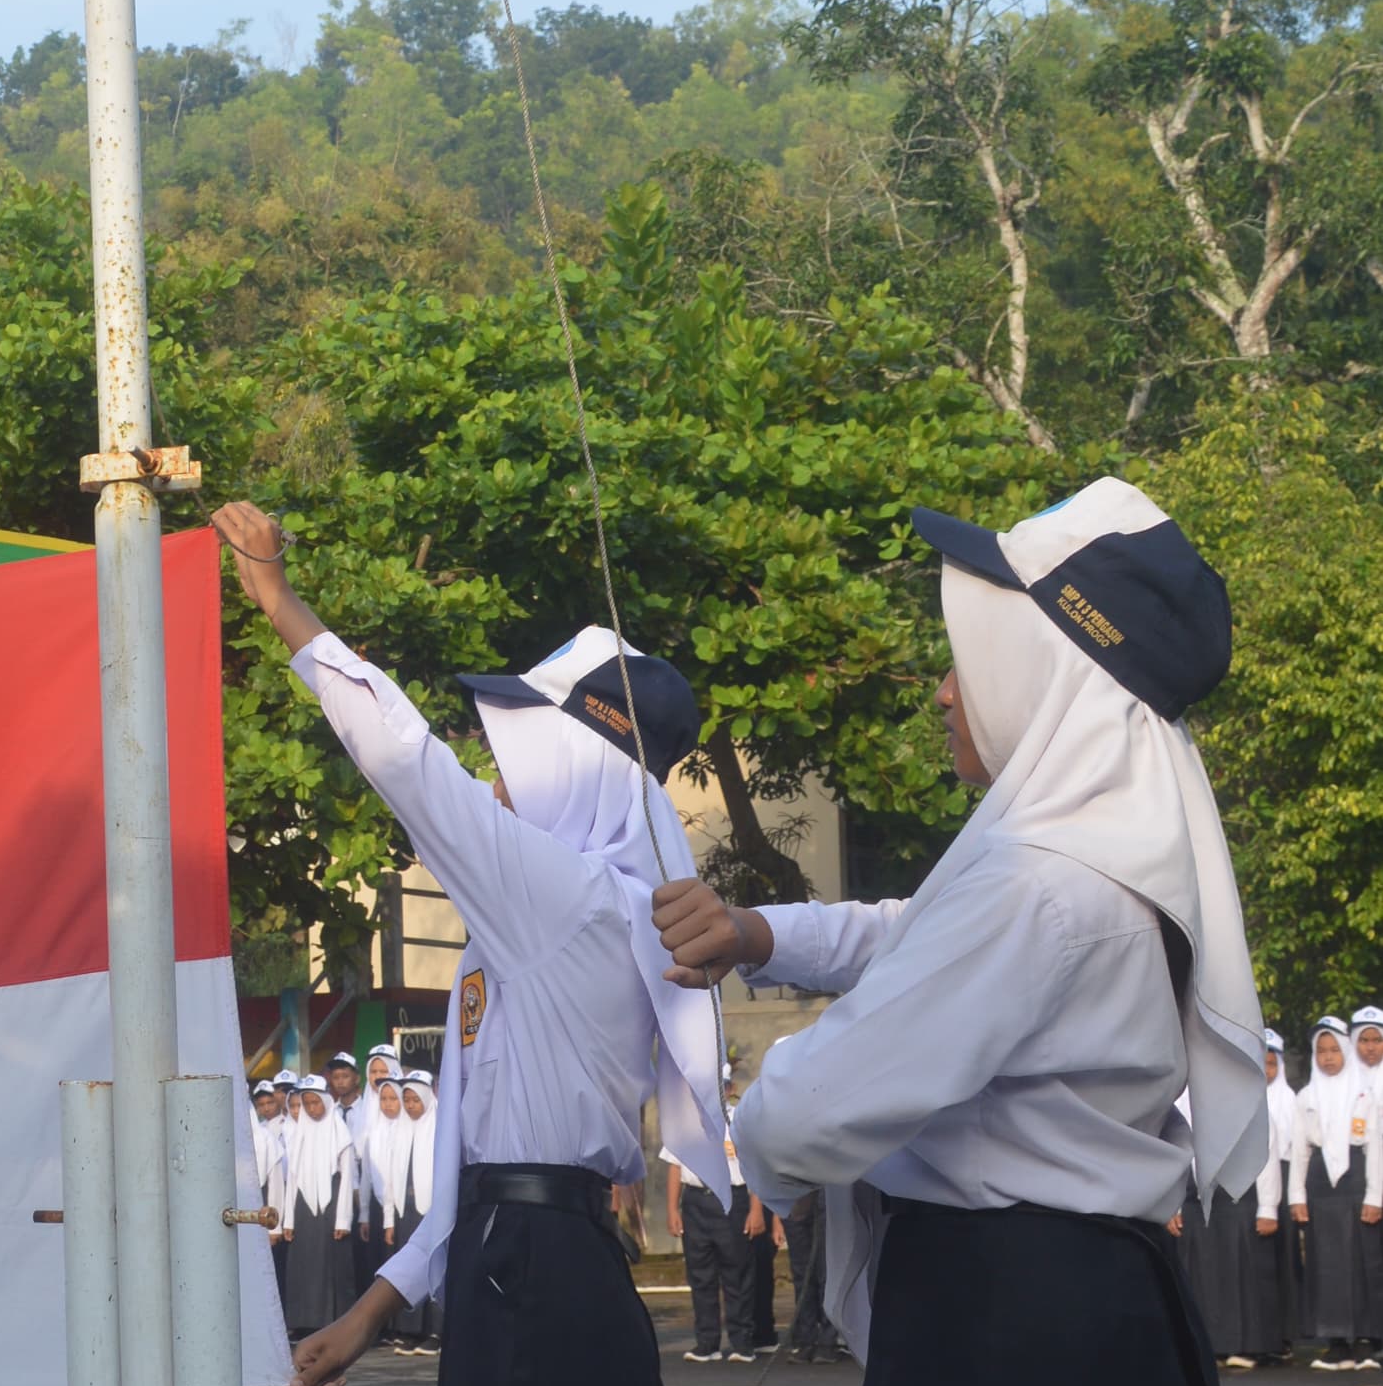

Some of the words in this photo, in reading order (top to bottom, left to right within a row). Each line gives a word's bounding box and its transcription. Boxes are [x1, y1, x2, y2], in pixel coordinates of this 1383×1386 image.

[1060, 583, 1081, 602] SMP
[1074, 597, 1088, 610] N
[1081, 604, 1093, 615] 3
[1056, 596, 1084, 625] KULON
[1080, 620, 1111, 648] PROGO
[1086, 609, 1125, 646] PENGASIH
